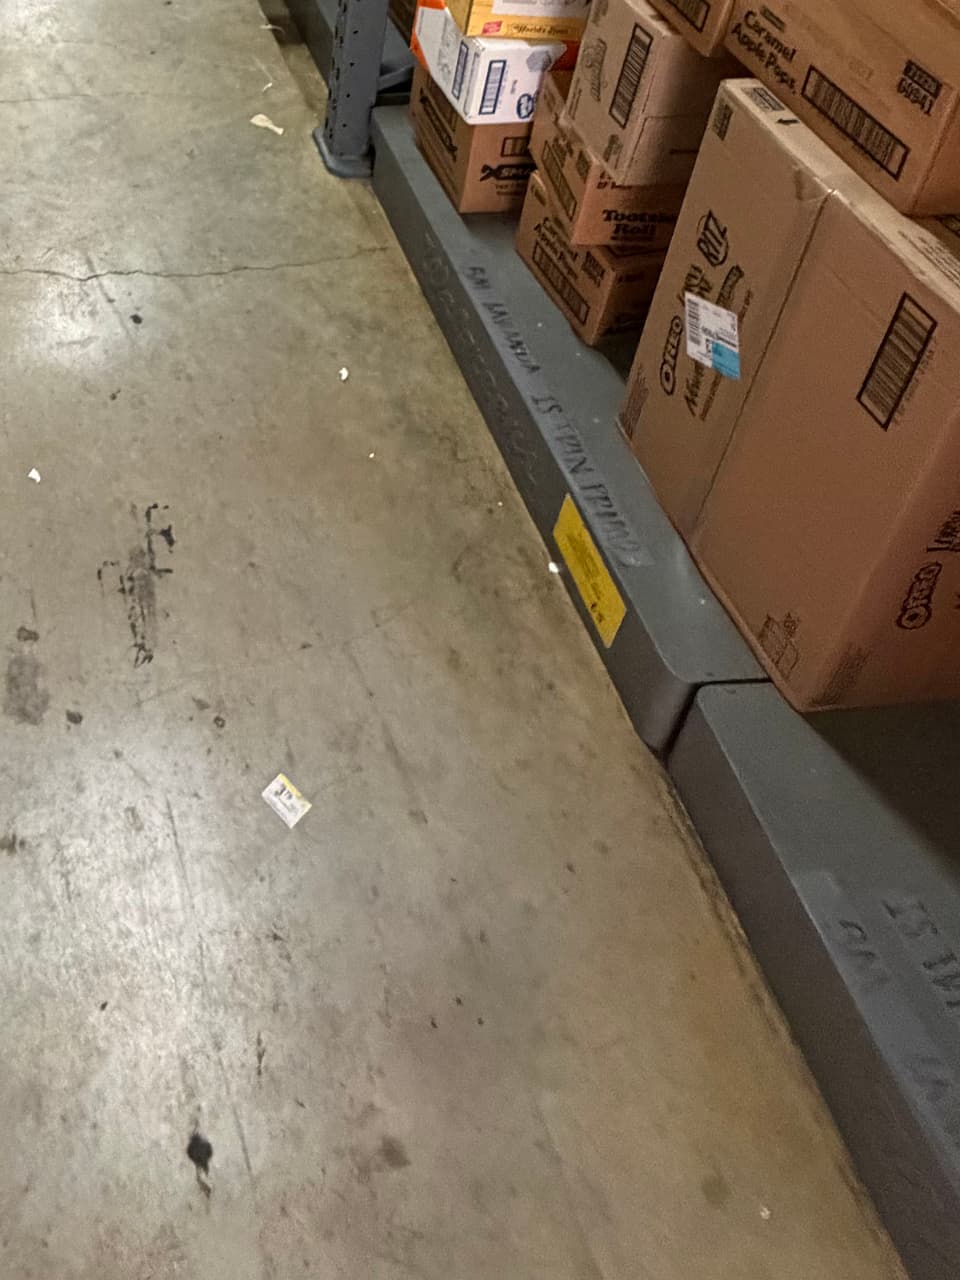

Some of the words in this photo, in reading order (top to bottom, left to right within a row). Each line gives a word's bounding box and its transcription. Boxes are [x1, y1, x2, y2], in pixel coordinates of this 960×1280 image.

[731, 23, 766, 62] Apple
[744, 10, 797, 63] Caramel
[698, 210, 728, 266] RITZ
[660, 316, 684, 396] OREO
[896, 560, 943, 631] OREO
